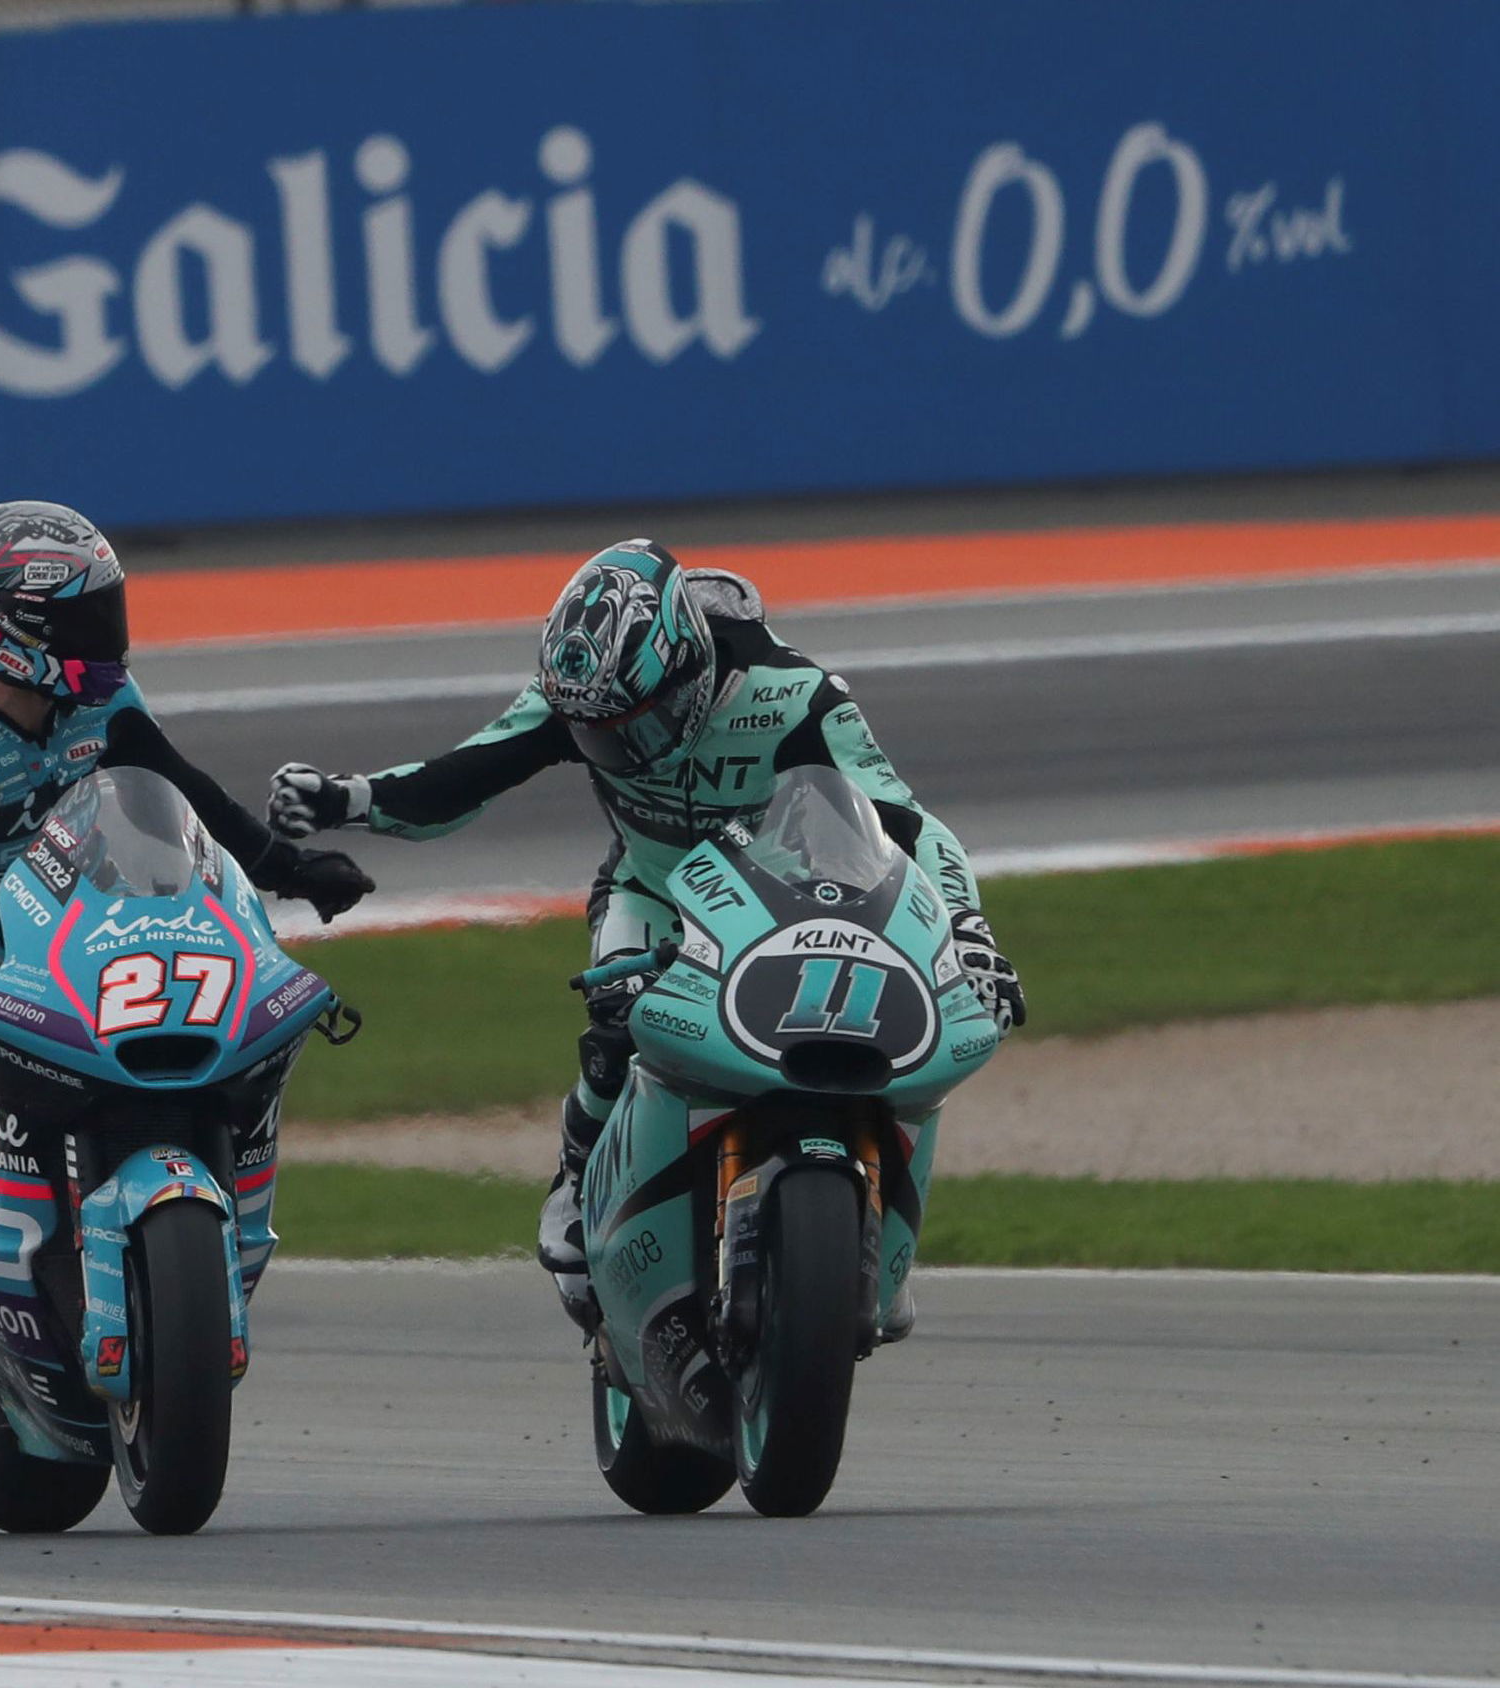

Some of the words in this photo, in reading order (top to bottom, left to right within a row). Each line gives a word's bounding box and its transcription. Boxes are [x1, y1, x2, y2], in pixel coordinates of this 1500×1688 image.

[950, 121, 1208, 337] 0,0
[0, 652, 30, 675] BELL
[751, 680, 810, 704] KLINT
[69, 741, 102, 761] BELL
[44, 820, 77, 849] WRS
[725, 820, 754, 849] WRS
[676, 853, 747, 913] KLINT
[936, 841, 970, 911] KLINT
[3, 872, 51, 927] CFMOTO
[84, 899, 221, 944] inde
[85, 934, 140, 955] SOLER
[146, 931, 226, 947] HISPANIA
[792, 929, 876, 954] KLINT
[95, 952, 236, 1038] 27
[277, 971, 318, 1004] solunion
[775, 958, 888, 1039] 11
